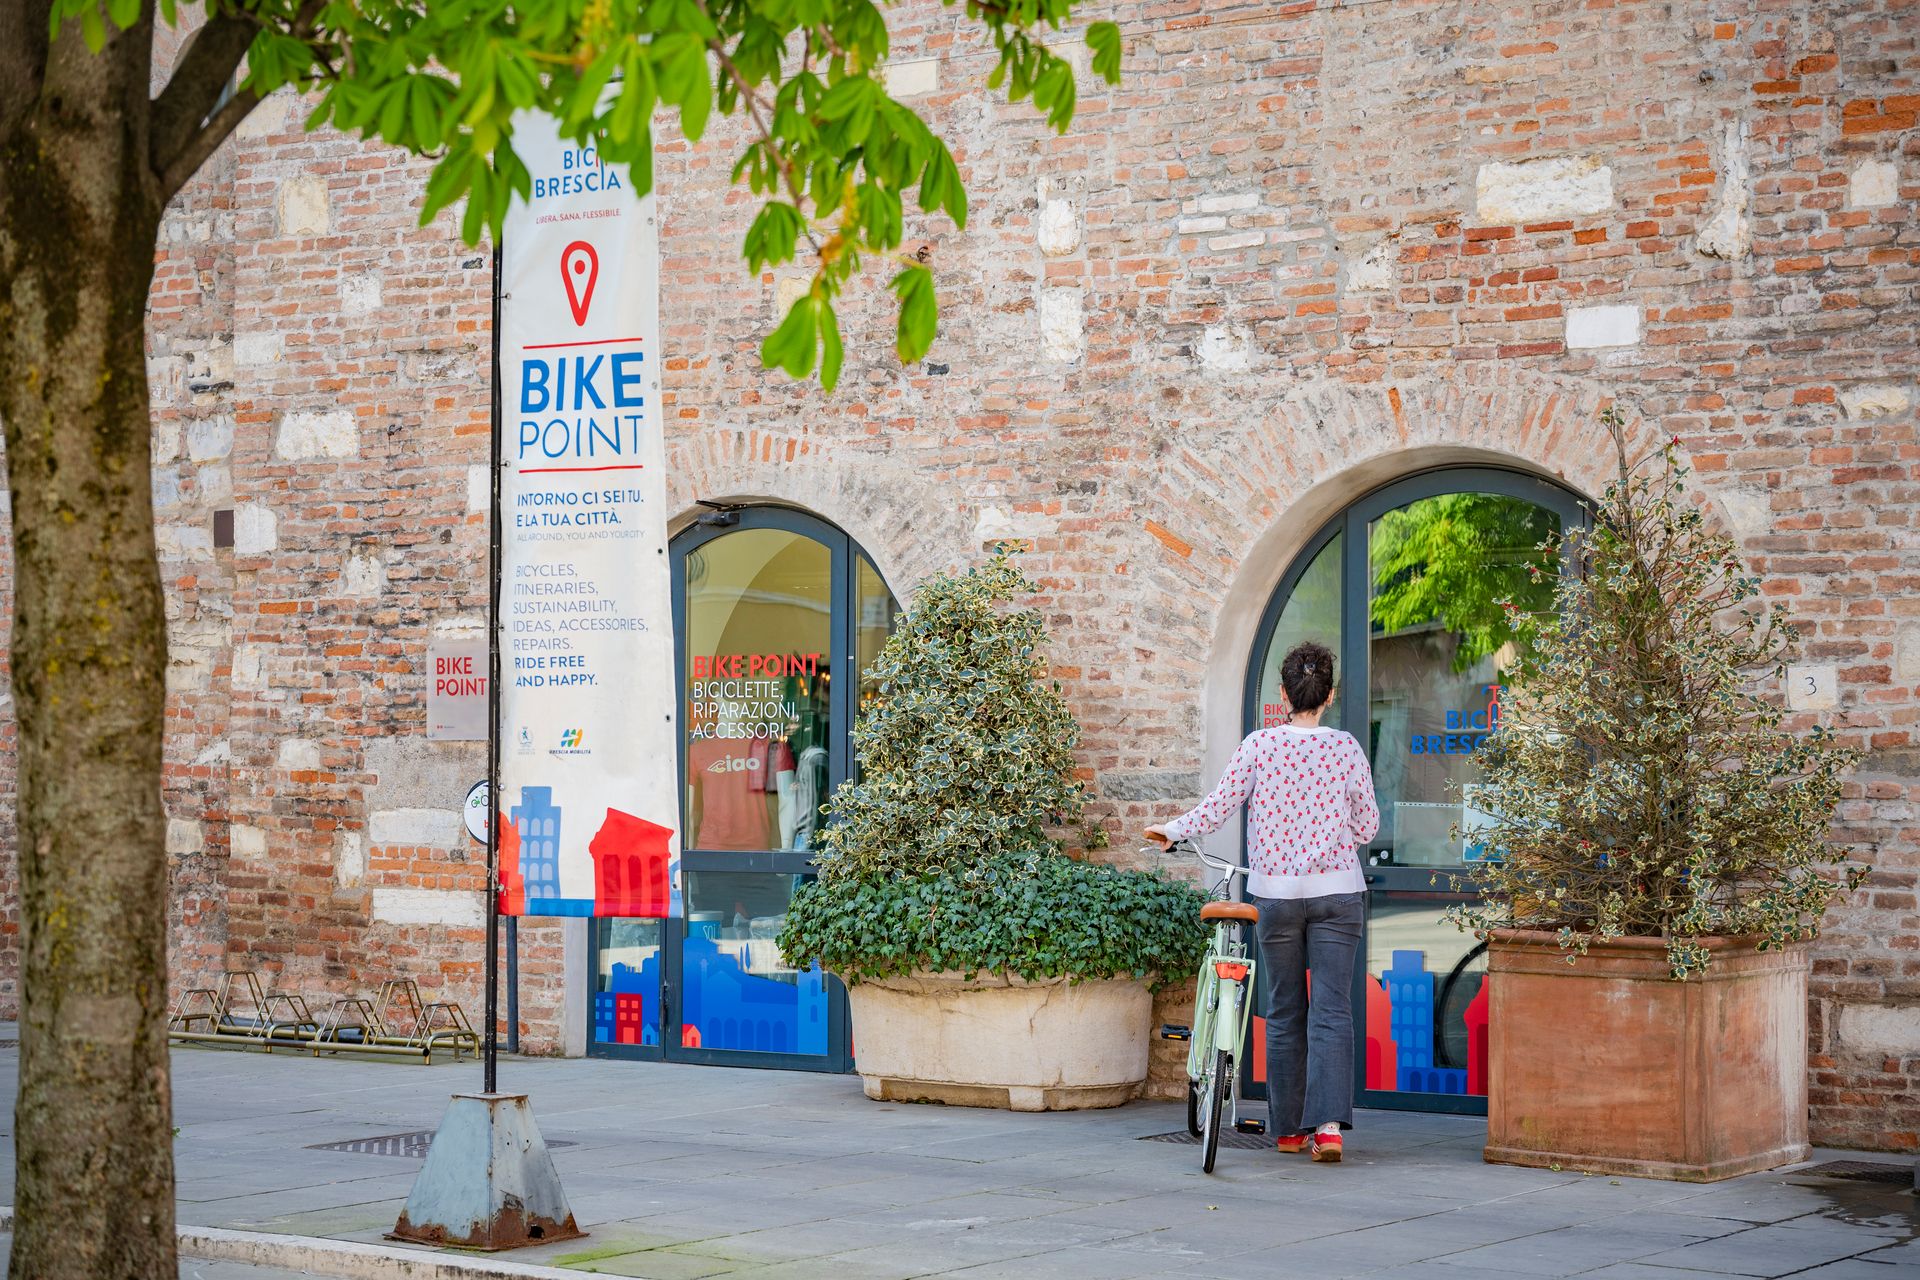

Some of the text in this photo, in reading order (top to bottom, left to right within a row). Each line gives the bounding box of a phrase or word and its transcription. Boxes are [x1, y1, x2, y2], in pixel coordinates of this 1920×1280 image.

[535, 159, 621, 198] BRESCIA
[520, 352, 644, 413] BIKE
[519, 415, 644, 459] POINT
[517, 489, 644, 506] INTORNO CI SEI TU.
[517, 507, 622, 527] E LA TUA CITTÀ.
[566, 532, 586, 540] YOU
[588, 531, 609, 539] AND
[516, 564, 578, 578] BICYCLES,
[514, 582, 599, 596] ITINERARIES,
[513, 599, 618, 614] SUSTAINABILITY,
[513, 618, 649, 633] IDEAS, ACCESSORIES,
[514, 638, 574, 651] REPAIRS.
[436, 657, 473, 675] BIKE
[515, 655, 585, 669] RIDE FREE
[692, 653, 820, 679] BIKE POINT
[436, 678, 487, 697] POINT
[516, 674, 598, 687] AND HAPPY.
[1804, 676, 1817, 696] 3
[693, 681, 784, 700] BICICLETTE,
[693, 702, 799, 722] RIPARAZIONI,
